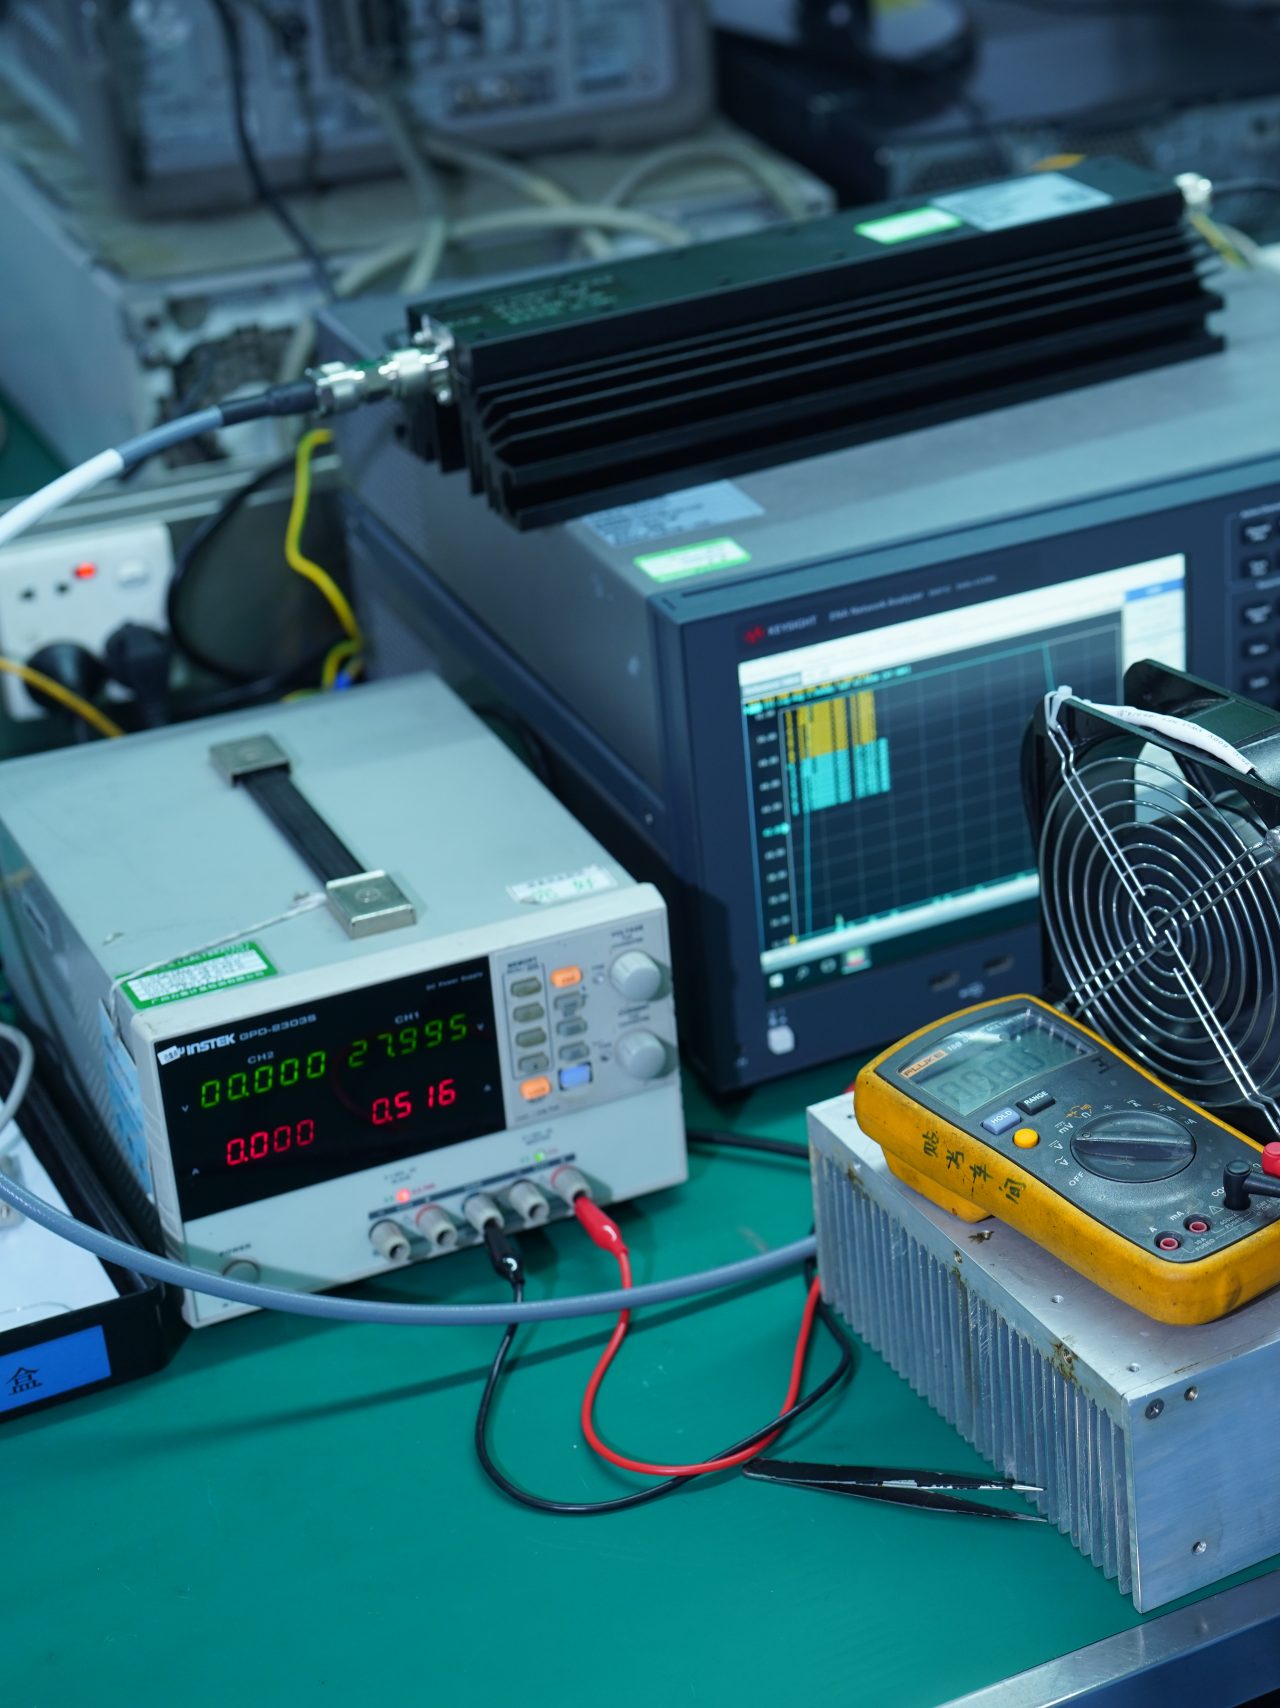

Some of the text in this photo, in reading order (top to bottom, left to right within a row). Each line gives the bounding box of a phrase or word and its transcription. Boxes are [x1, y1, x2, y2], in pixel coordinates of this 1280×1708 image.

[851, 598, 887, 616] Network
[767, 615, 818, 637] KEYSIGHT
[394, 1011, 420, 1025] CH1
[186, 1032, 236, 1056] INSTEK
[239, 1013, 318, 1042] GPD-2303S
[247, 1050, 275, 1065] CH2
[903, 1051, 946, 1078] FLUKE
[200, 1050, 327, 1109] 00.000
[371, 1078, 457, 1125] 0.516
[1023, 1090, 1049, 1106] RANGE
[991, 1109, 1014, 1125] HOLD
[226, 1118, 315, 1166] 0.000
[1068, 1170, 1085, 1187] OFF
[1211, 1186, 1225, 1197] CO
